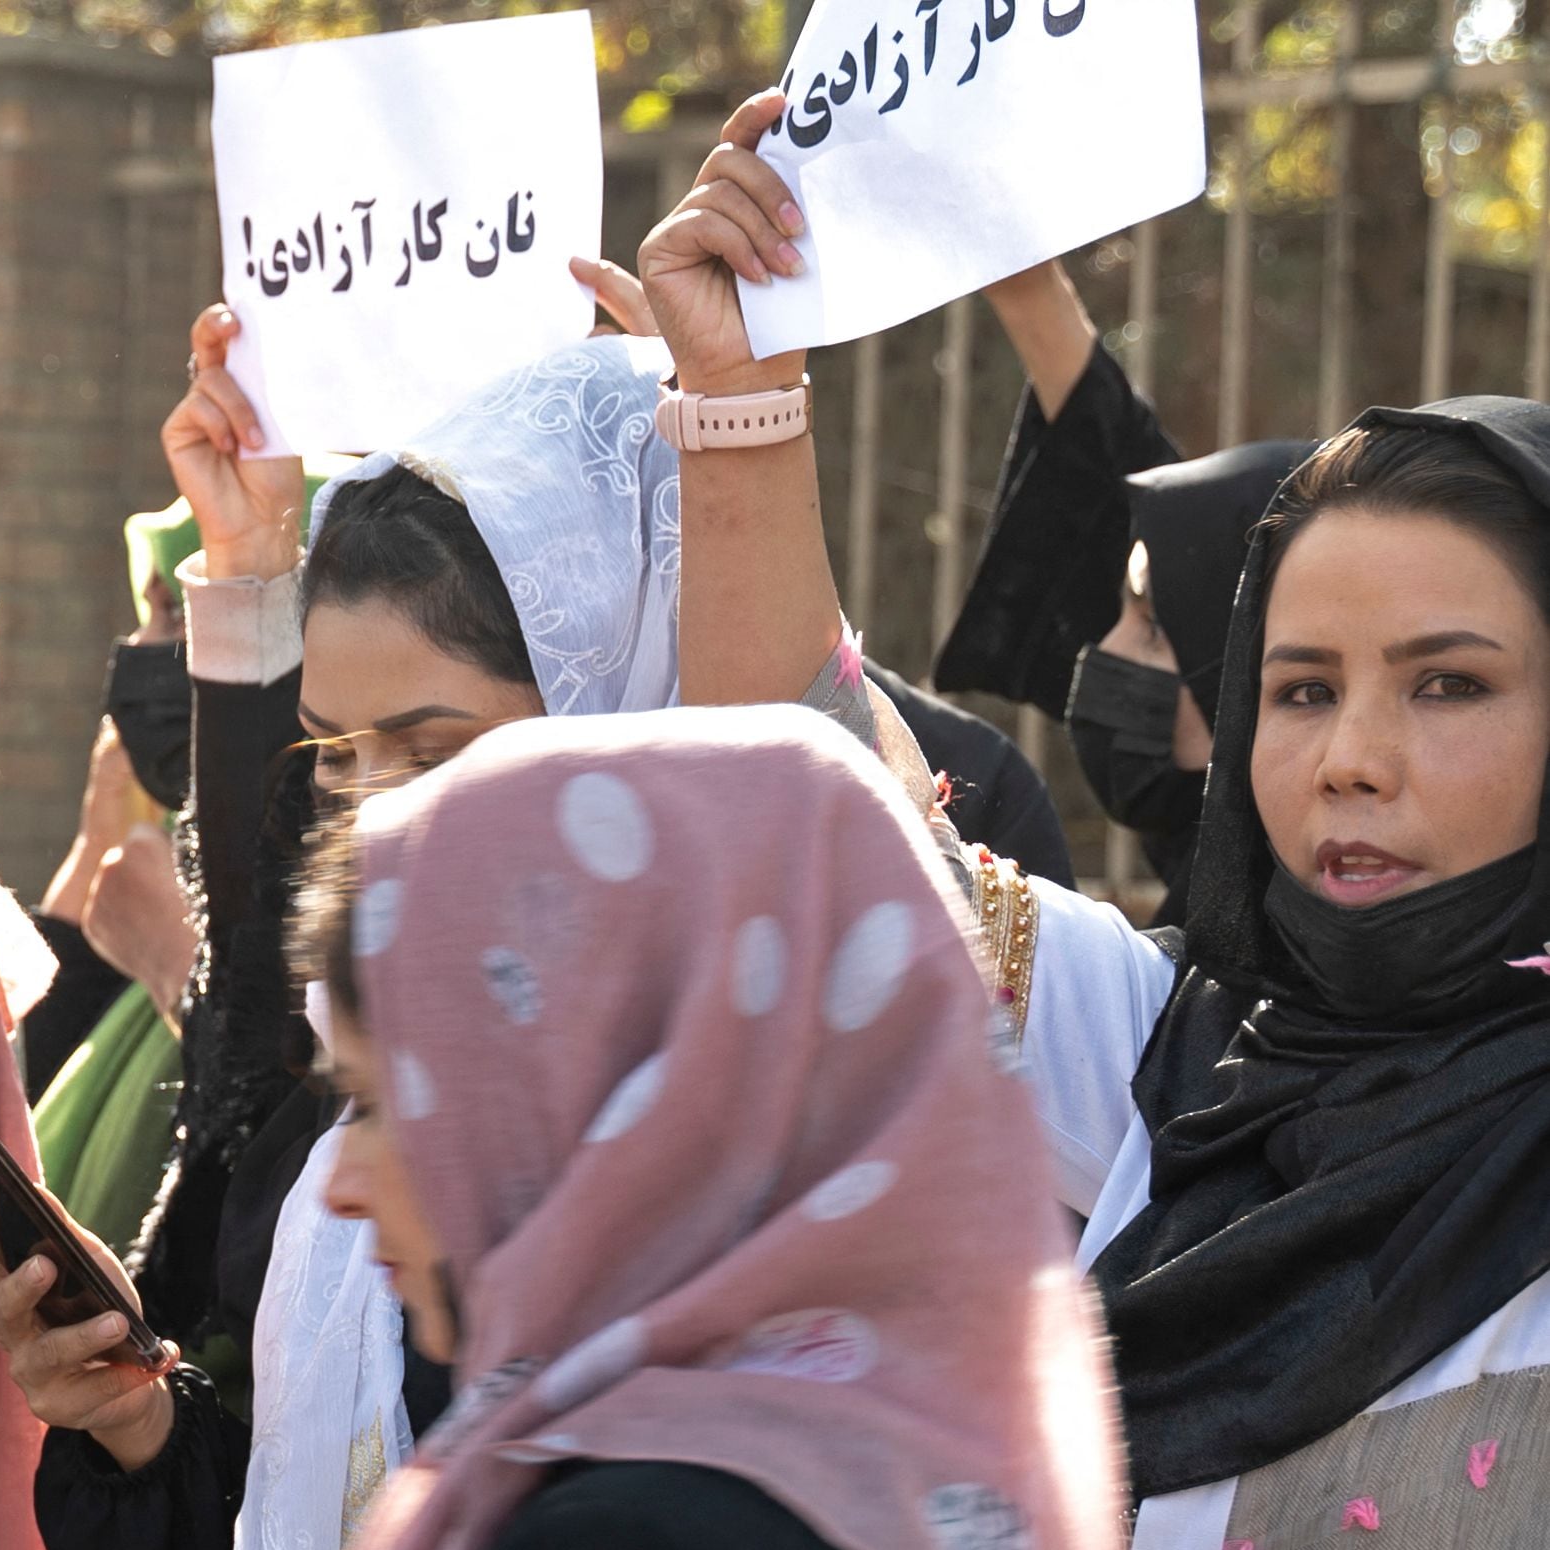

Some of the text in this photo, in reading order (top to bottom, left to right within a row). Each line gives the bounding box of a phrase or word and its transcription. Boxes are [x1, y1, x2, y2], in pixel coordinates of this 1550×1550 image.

[242, 190, 536, 298] نان کار آزادی!
